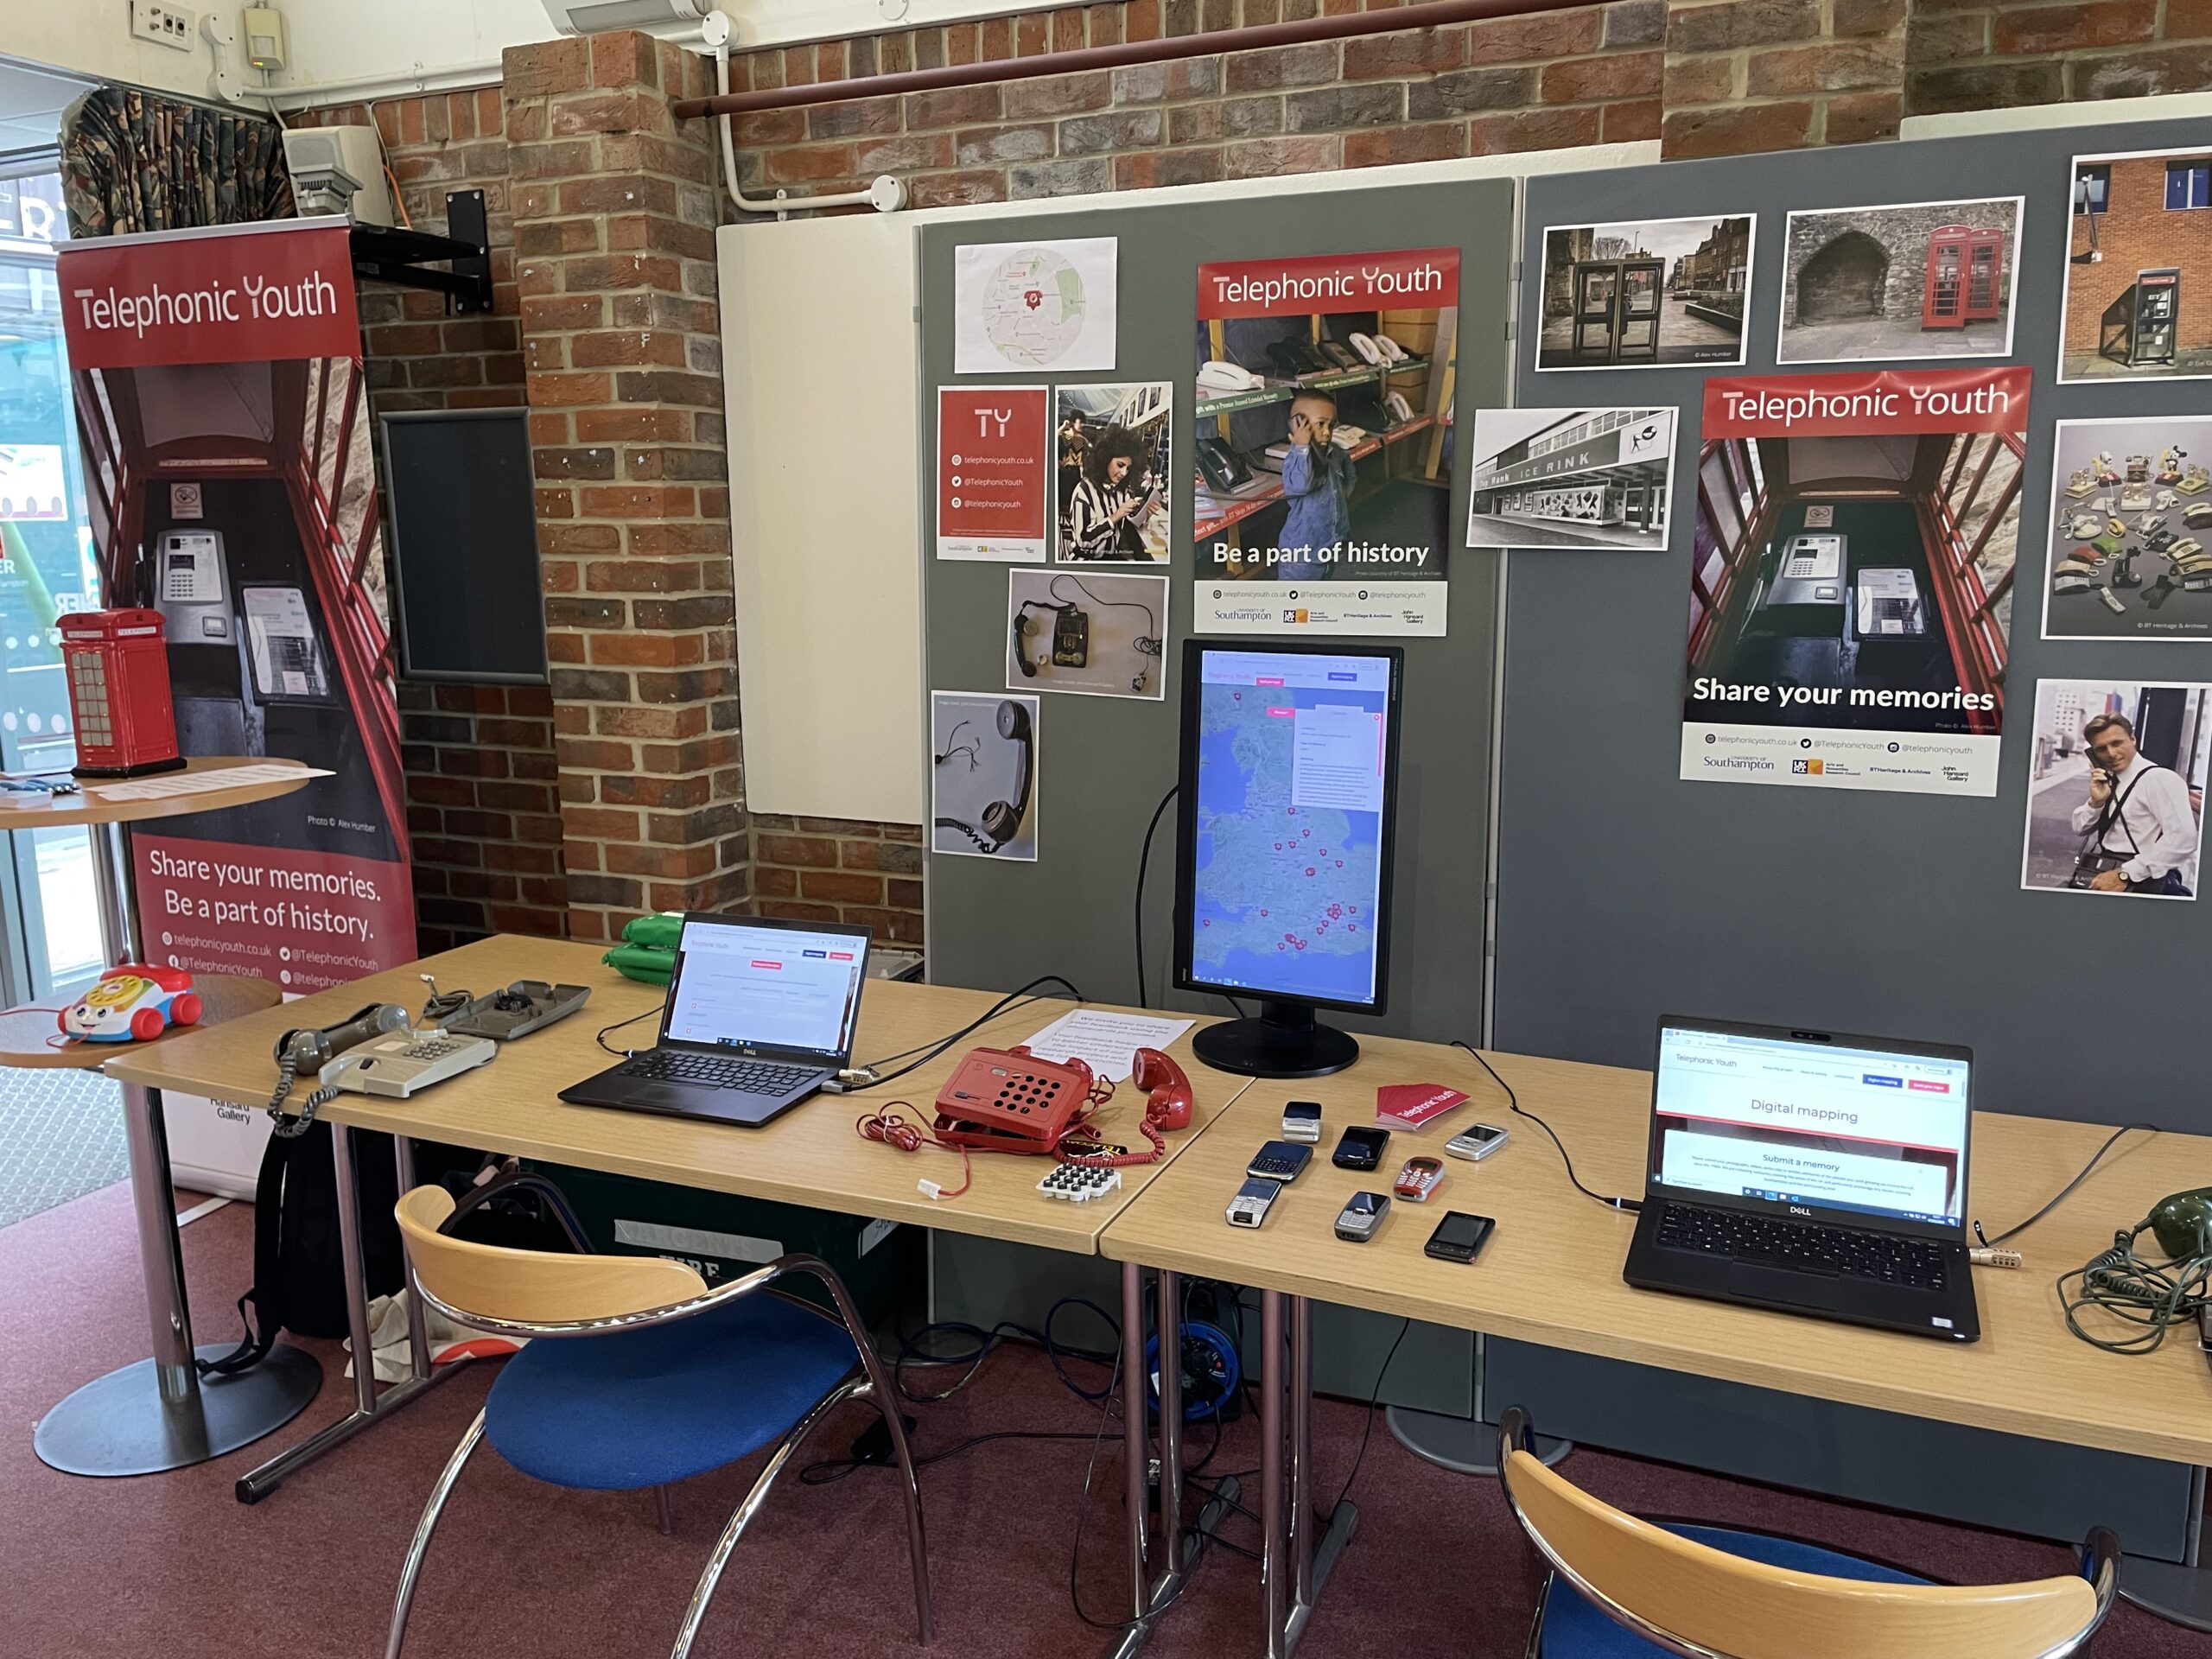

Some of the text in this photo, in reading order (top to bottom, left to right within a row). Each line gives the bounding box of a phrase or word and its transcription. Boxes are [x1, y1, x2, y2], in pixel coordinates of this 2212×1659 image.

[1213, 263, 1442, 308] Telephonic Youth
[73, 270, 336, 339] Telephonic Youth
[1723, 384, 2009, 428] Telephonic Youth
[974, 409, 1012, 438] TY
[963, 456, 1035, 466] telephonicyouth.co.uk
[1491, 473, 1510, 485] Rank
[1521, 467, 1538, 479] ICE
[1547, 452, 1589, 474] RINK
[963, 478, 1024, 488] @TelephonicYouth
[963, 499, 1021, 510] @telephonicyouth
[1213, 542, 1429, 566] Be a part of history
[1215, 610, 1272, 622] Southampton
[1694, 677, 1995, 712] Share your memories
[1718, 735, 1797, 747] telephonicyouth.co.uk
[1814, 740, 1885, 750] @TelephonicYouth
[1902, 745, 1973, 755] @telephonicyouth
[1704, 756, 1774, 771] Southampton
[307, 815, 328, 827] Photo
[338, 819, 352, 830] Alex
[352, 822, 376, 833] Humber
[149, 849, 382, 902] Share your memories.
[164, 888, 374, 943] Be a part of history.
[174, 934, 272, 957] telephonicyouth.co.uk
[291, 949, 379, 972] @TelephonicYouth
[743, 1048, 757, 1057] DELL
[1675, 1052, 1737, 1068] Telephonic Youth
[1396, 1090, 1458, 1118] Telephonic Youth
[1751, 1099, 1858, 1124] Digital mapping
[217, 1108, 251, 1126] Gallery
[1763, 1154, 1794, 1165] Submit
[1803, 1161, 1840, 1173] memory
[1789, 1206, 1811, 1216] DELL
